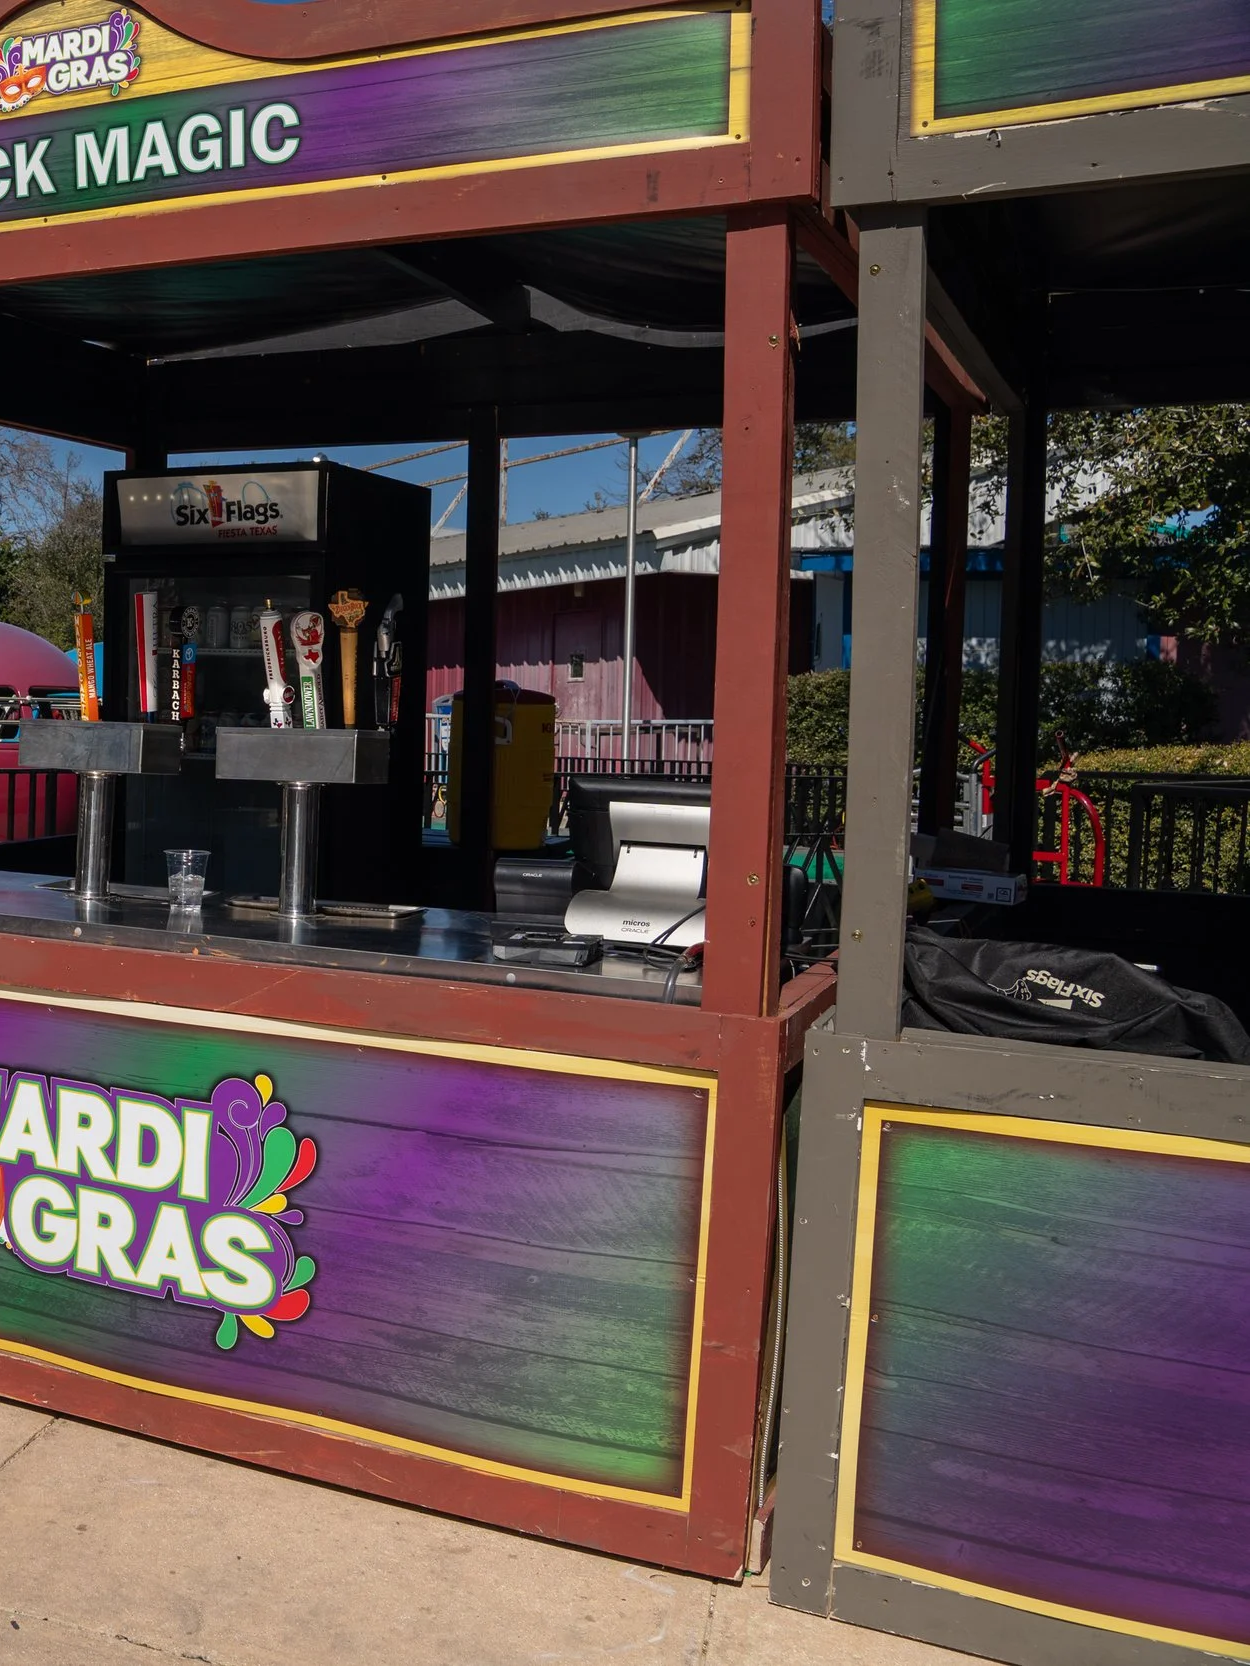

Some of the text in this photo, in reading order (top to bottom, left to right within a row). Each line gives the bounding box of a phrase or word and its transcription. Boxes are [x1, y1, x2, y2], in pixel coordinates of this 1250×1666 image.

[21, 26, 111, 65] MARDI
[47, 53, 129, 93] GRAS
[75, 103, 300, 189] MAGIC
[176, 500, 280, 526] Six Flags
[218, 525, 278, 538] FIESTA TEXAS
[84, 639, 96, 699] MANGO WHEAT ALE
[171, 648, 181, 721] KARBACH
[303, 681, 315, 728] LAWNMOWER
[622, 919, 651, 928] micros
[8, 1175, 276, 1310] GRAS
